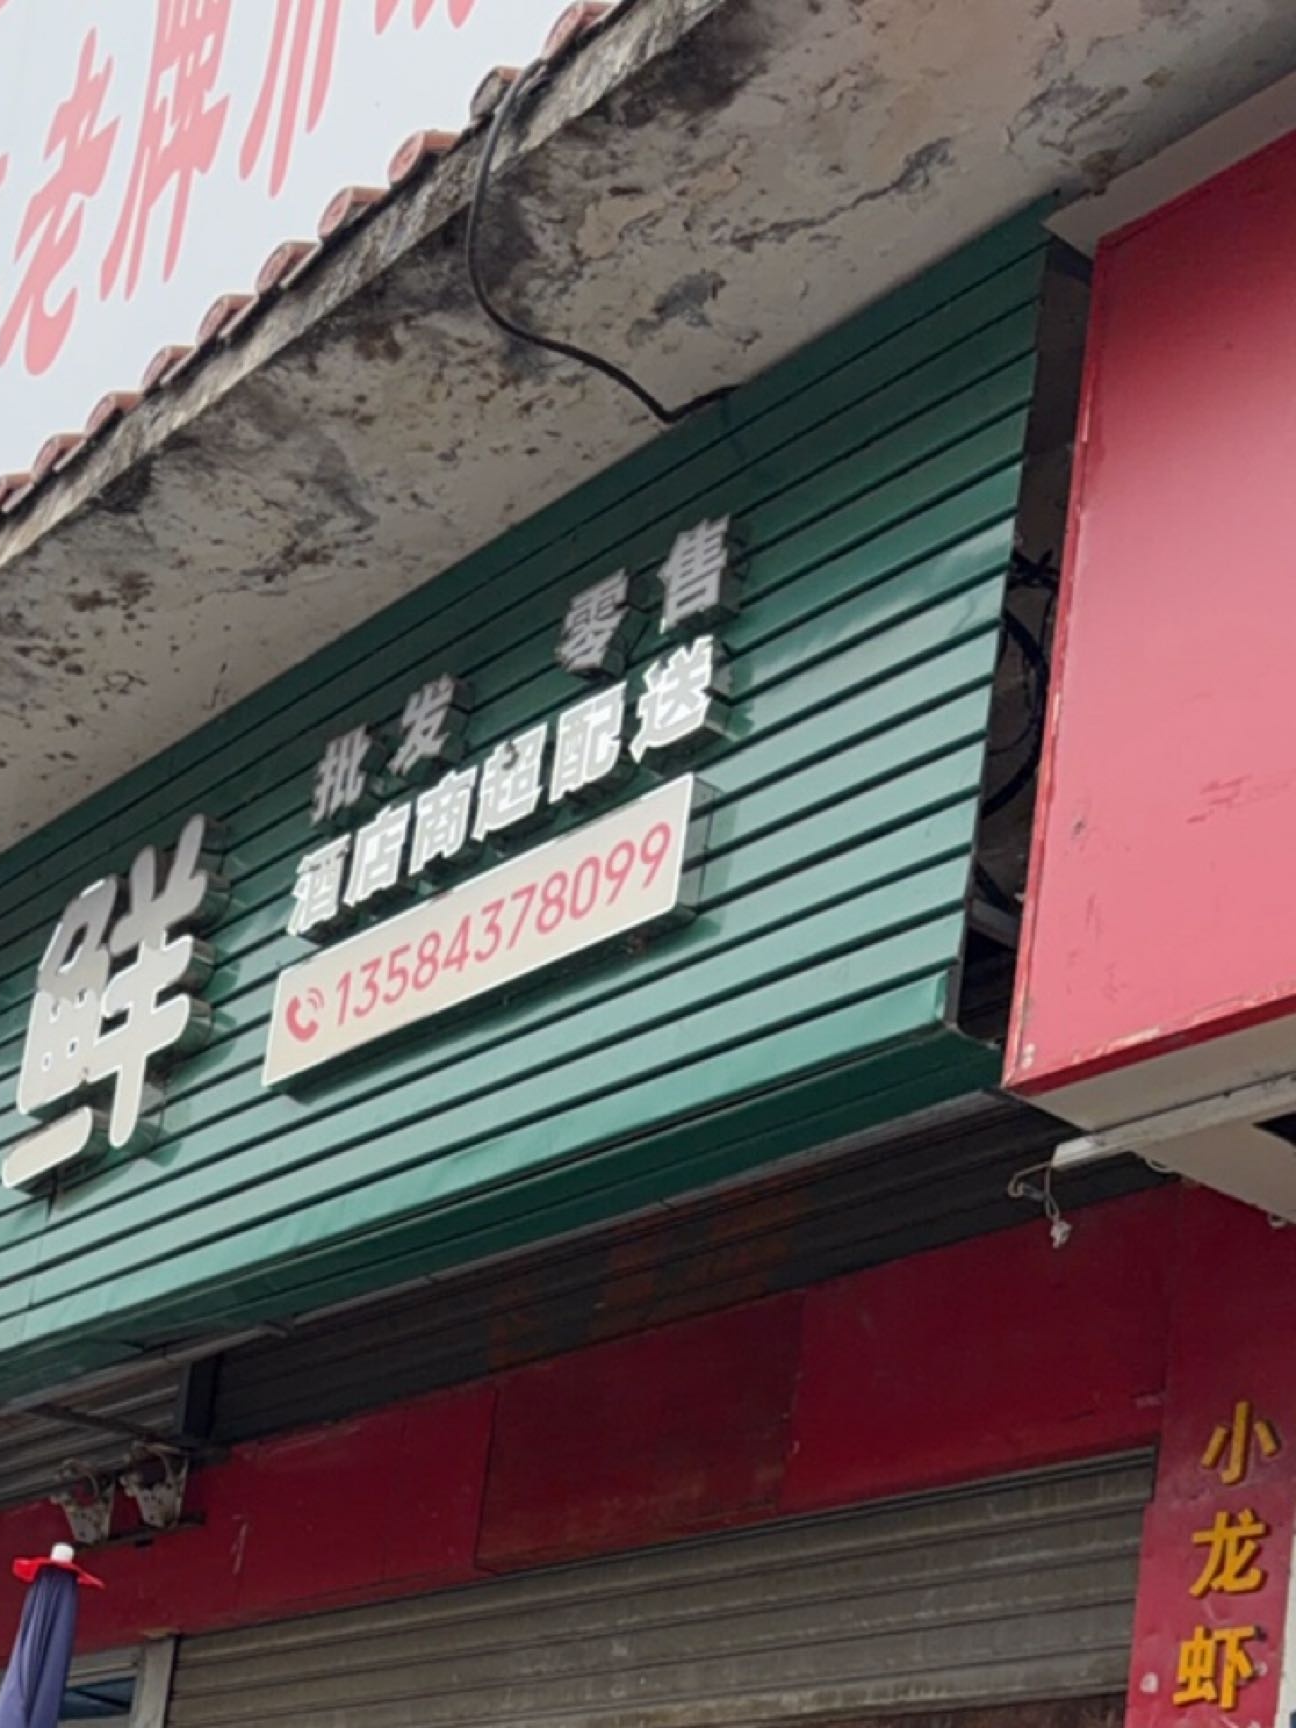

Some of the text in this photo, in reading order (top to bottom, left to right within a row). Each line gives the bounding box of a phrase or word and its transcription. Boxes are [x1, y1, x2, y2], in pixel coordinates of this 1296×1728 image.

[288, 635, 714, 936] 酒店商超配送
[311, 673, 456, 827] 批发
[335, 821, 672, 1027] 13584378099
